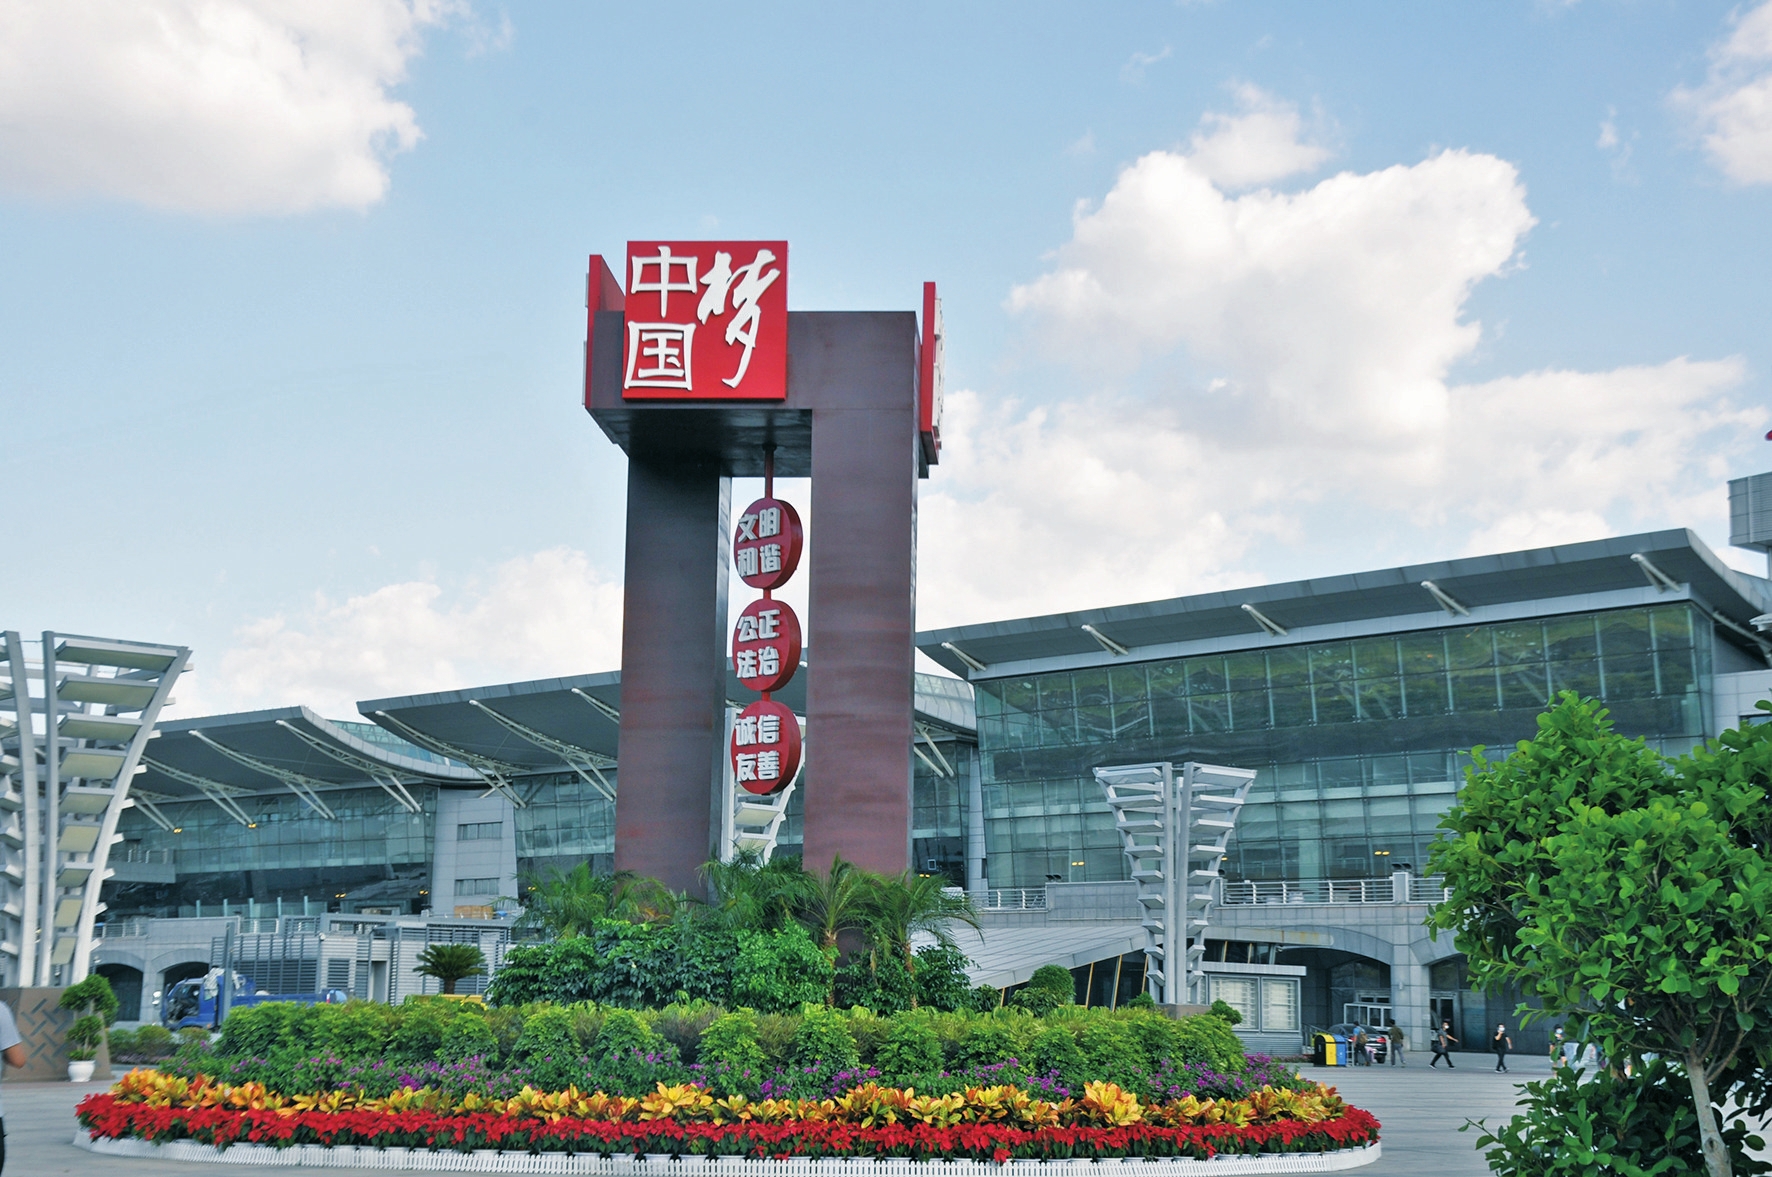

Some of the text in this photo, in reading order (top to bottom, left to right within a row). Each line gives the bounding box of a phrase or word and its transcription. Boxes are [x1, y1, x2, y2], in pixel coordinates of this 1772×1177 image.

[624, 246, 697, 391] 中国
[697, 249, 780, 388] 梦
[738, 507, 780, 543] 文明
[738, 543, 781, 577] 和谐
[737, 609, 780, 643] 公正
[736, 646, 779, 679] 法治
[735, 715, 780, 747] 诚信
[736, 750, 780, 782] 友善
